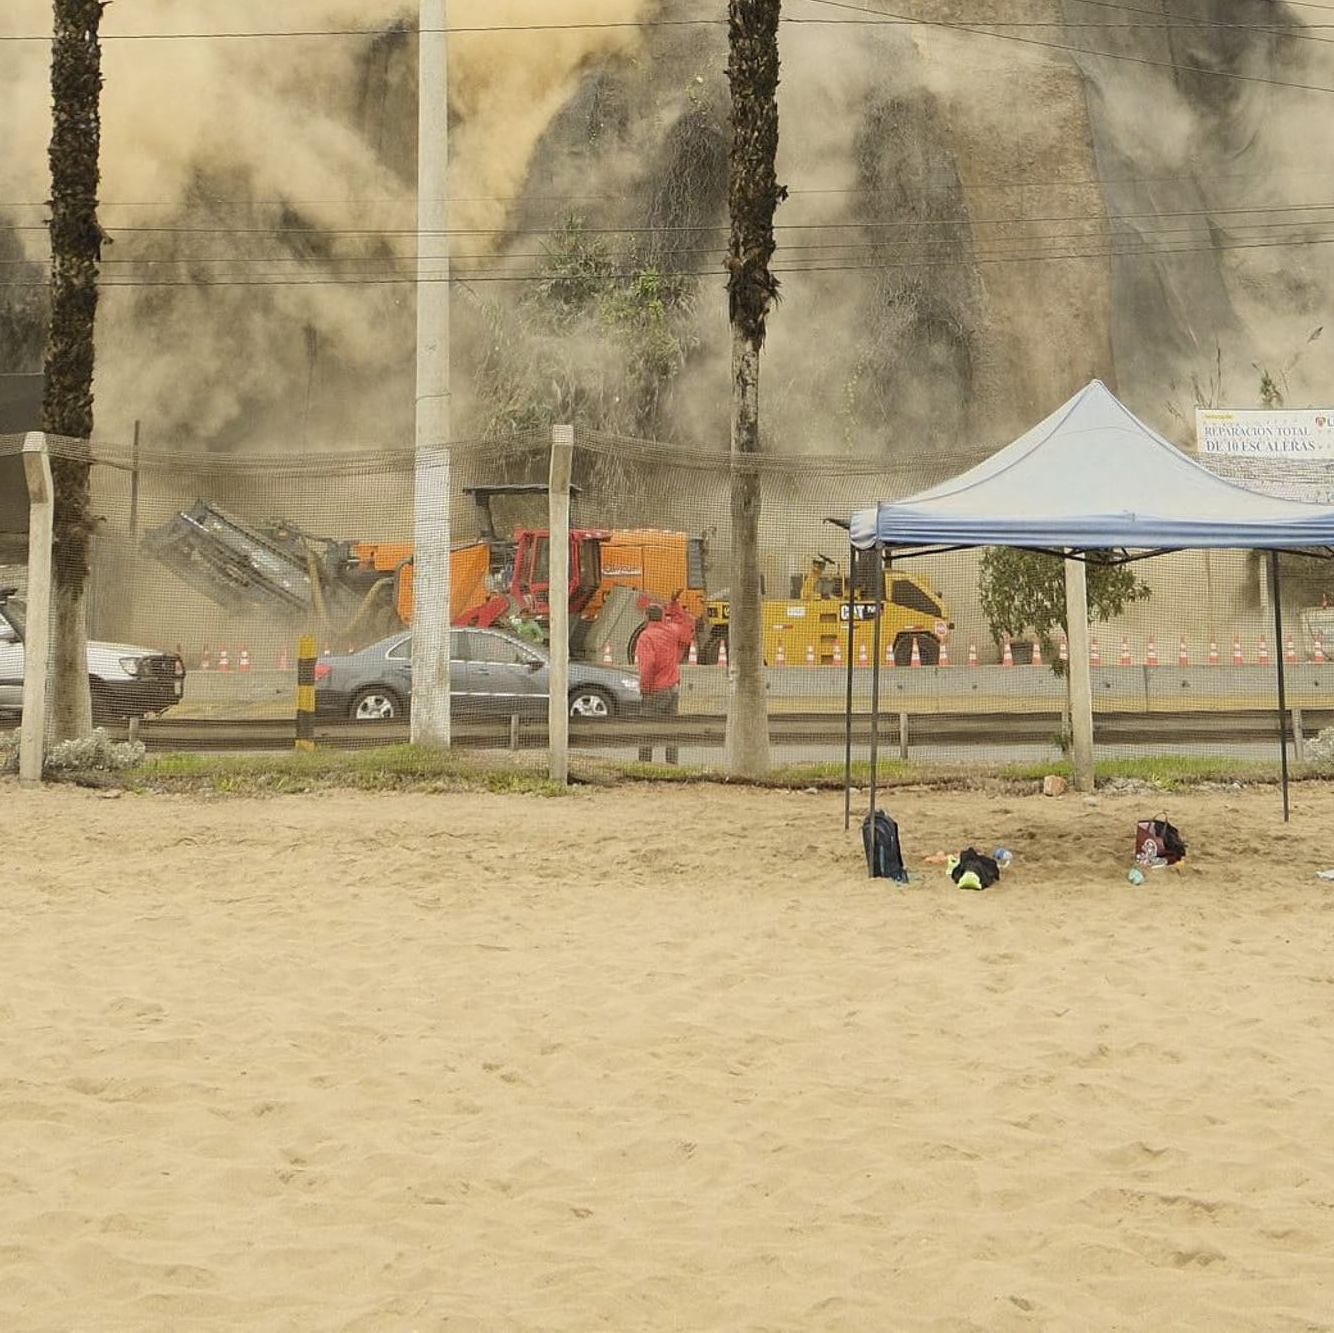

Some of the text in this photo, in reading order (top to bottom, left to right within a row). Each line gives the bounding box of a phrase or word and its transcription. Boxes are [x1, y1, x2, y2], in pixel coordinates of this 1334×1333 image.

[1277, 426, 1310, 436] TOTAL
[1206, 440, 1315, 452] DE 10 ESCALERAS
